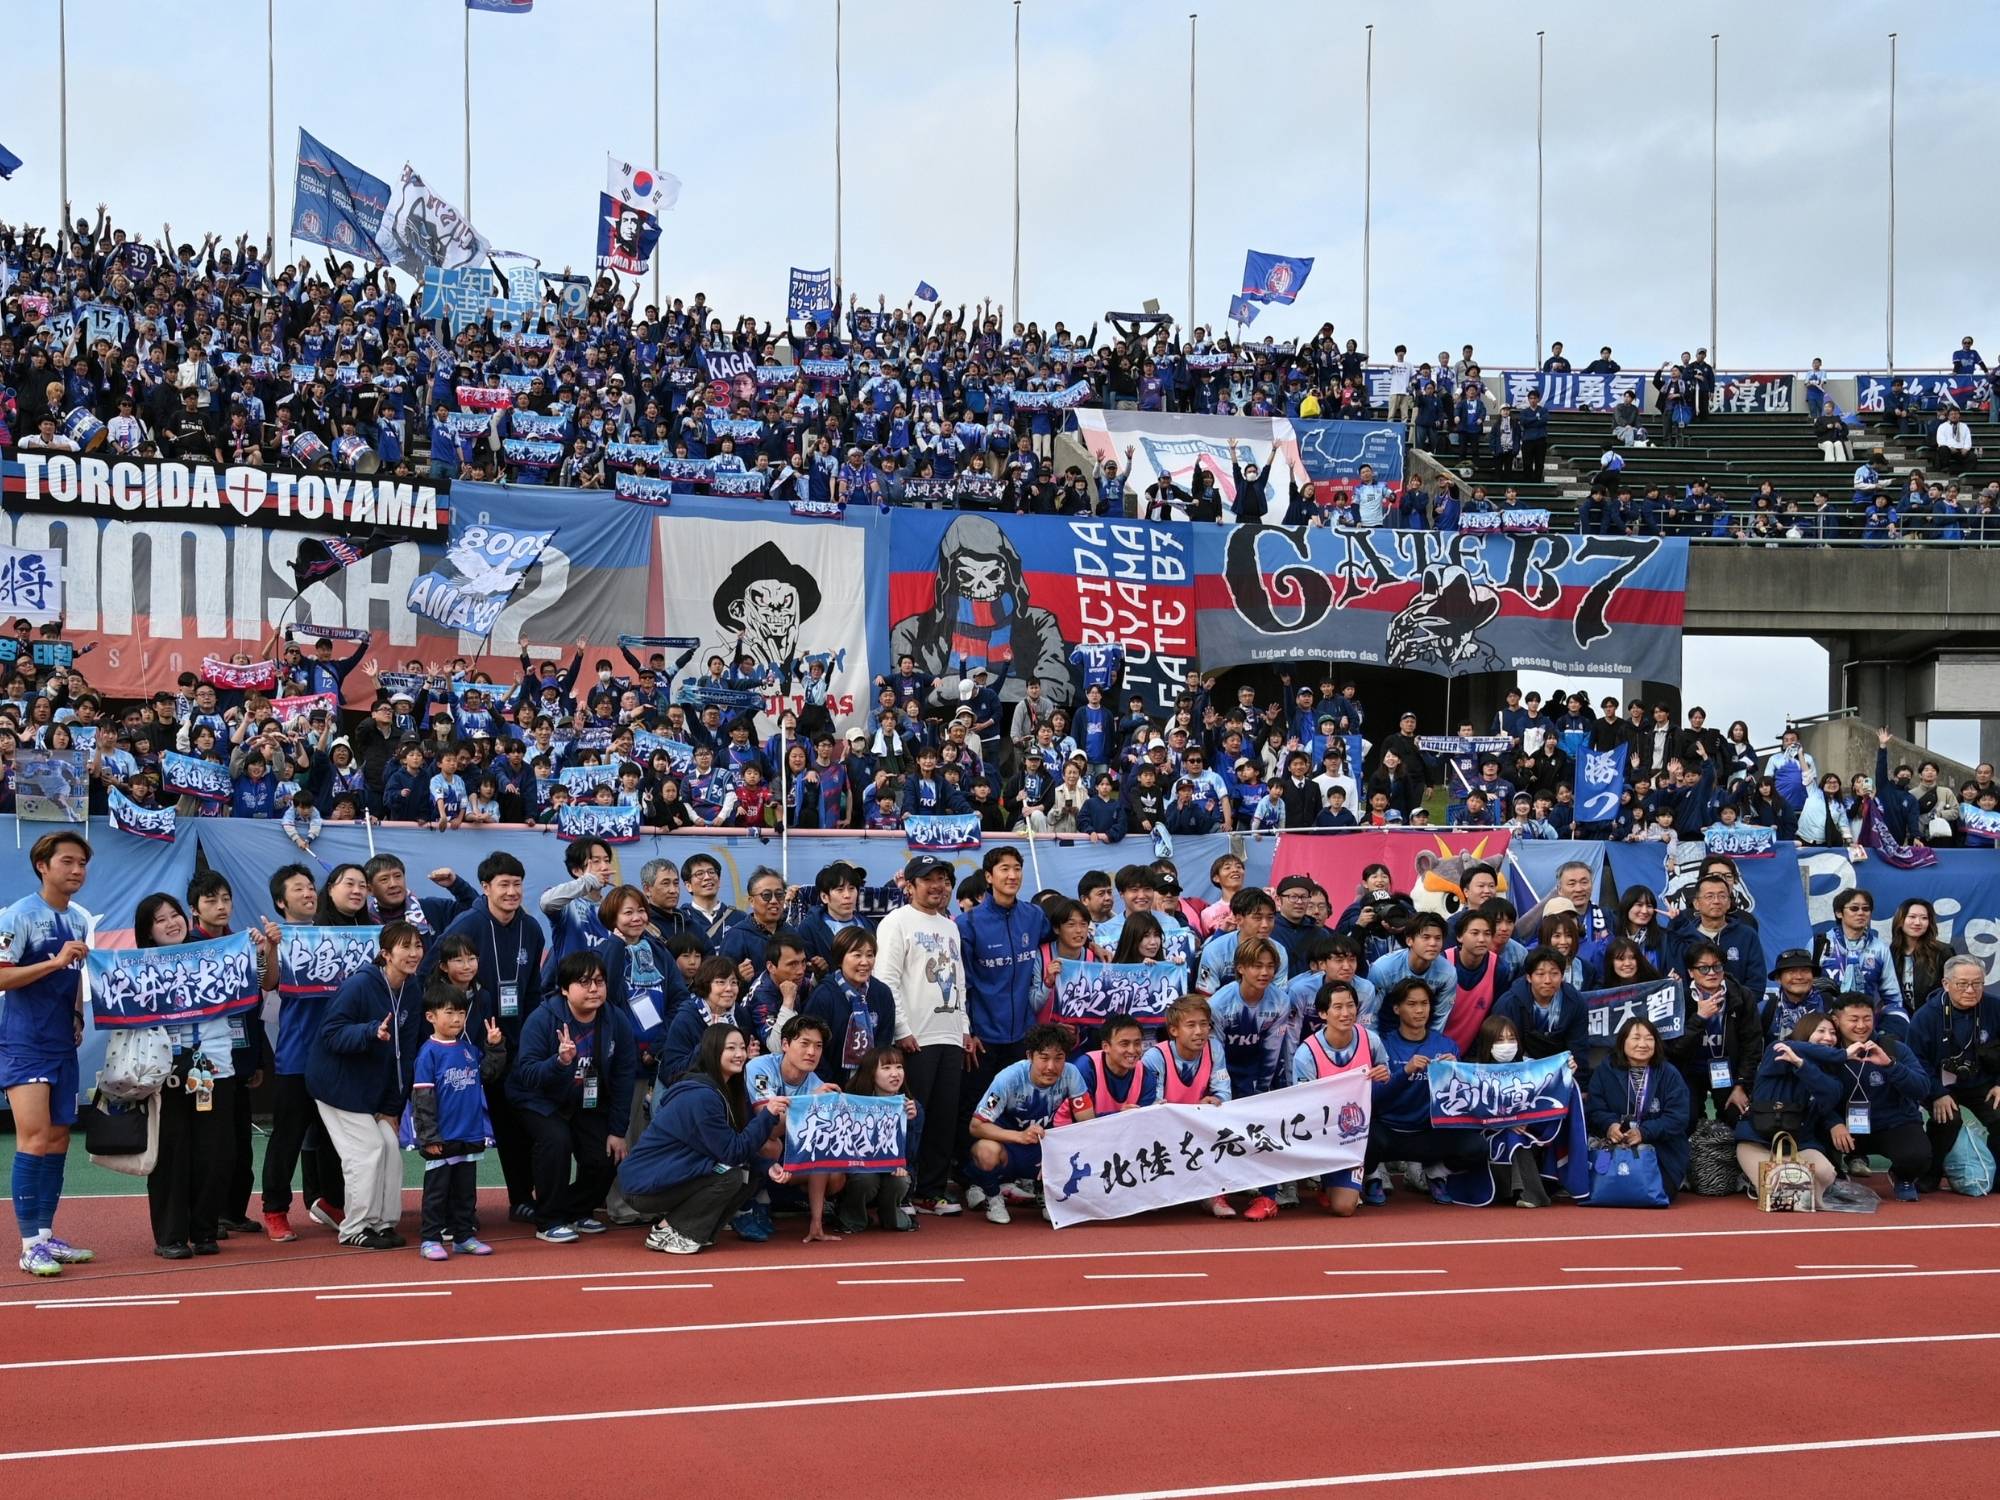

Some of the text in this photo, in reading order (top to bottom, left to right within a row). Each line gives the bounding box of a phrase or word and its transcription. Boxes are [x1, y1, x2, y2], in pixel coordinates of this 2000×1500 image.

[130, 249, 148, 268] 39
[563, 284, 586, 316] 9
[52, 321, 73, 338] 56
[94, 310, 111, 329] 15
[706, 351, 756, 380] KAGA
[1508, 373, 1640, 410] 香川勇気
[17, 453, 438, 531] TORCIDA TOYAMA
[1150, 528, 1186, 581] B7
[1223, 522, 1663, 651] GATE B7
[1110, 525, 1151, 690] TOYAMA
[331, 628, 355, 638] TOYAMA
[1090, 648, 1106, 667] 15
[1251, 647, 1379, 662] Lugar de encontro das
[1511, 657, 1551, 669] pessoas
[1552, 660, 1568, 673] que
[1418, 741, 1509, 752] KATALLER TOYAMA
[101, 952, 249, 1016] 坪井清志郎
[852, 1031, 868, 1050] 33
[1437, 1072, 1564, 1117] 古川真人
[798, 1112, 900, 1162] 布施谷翔
